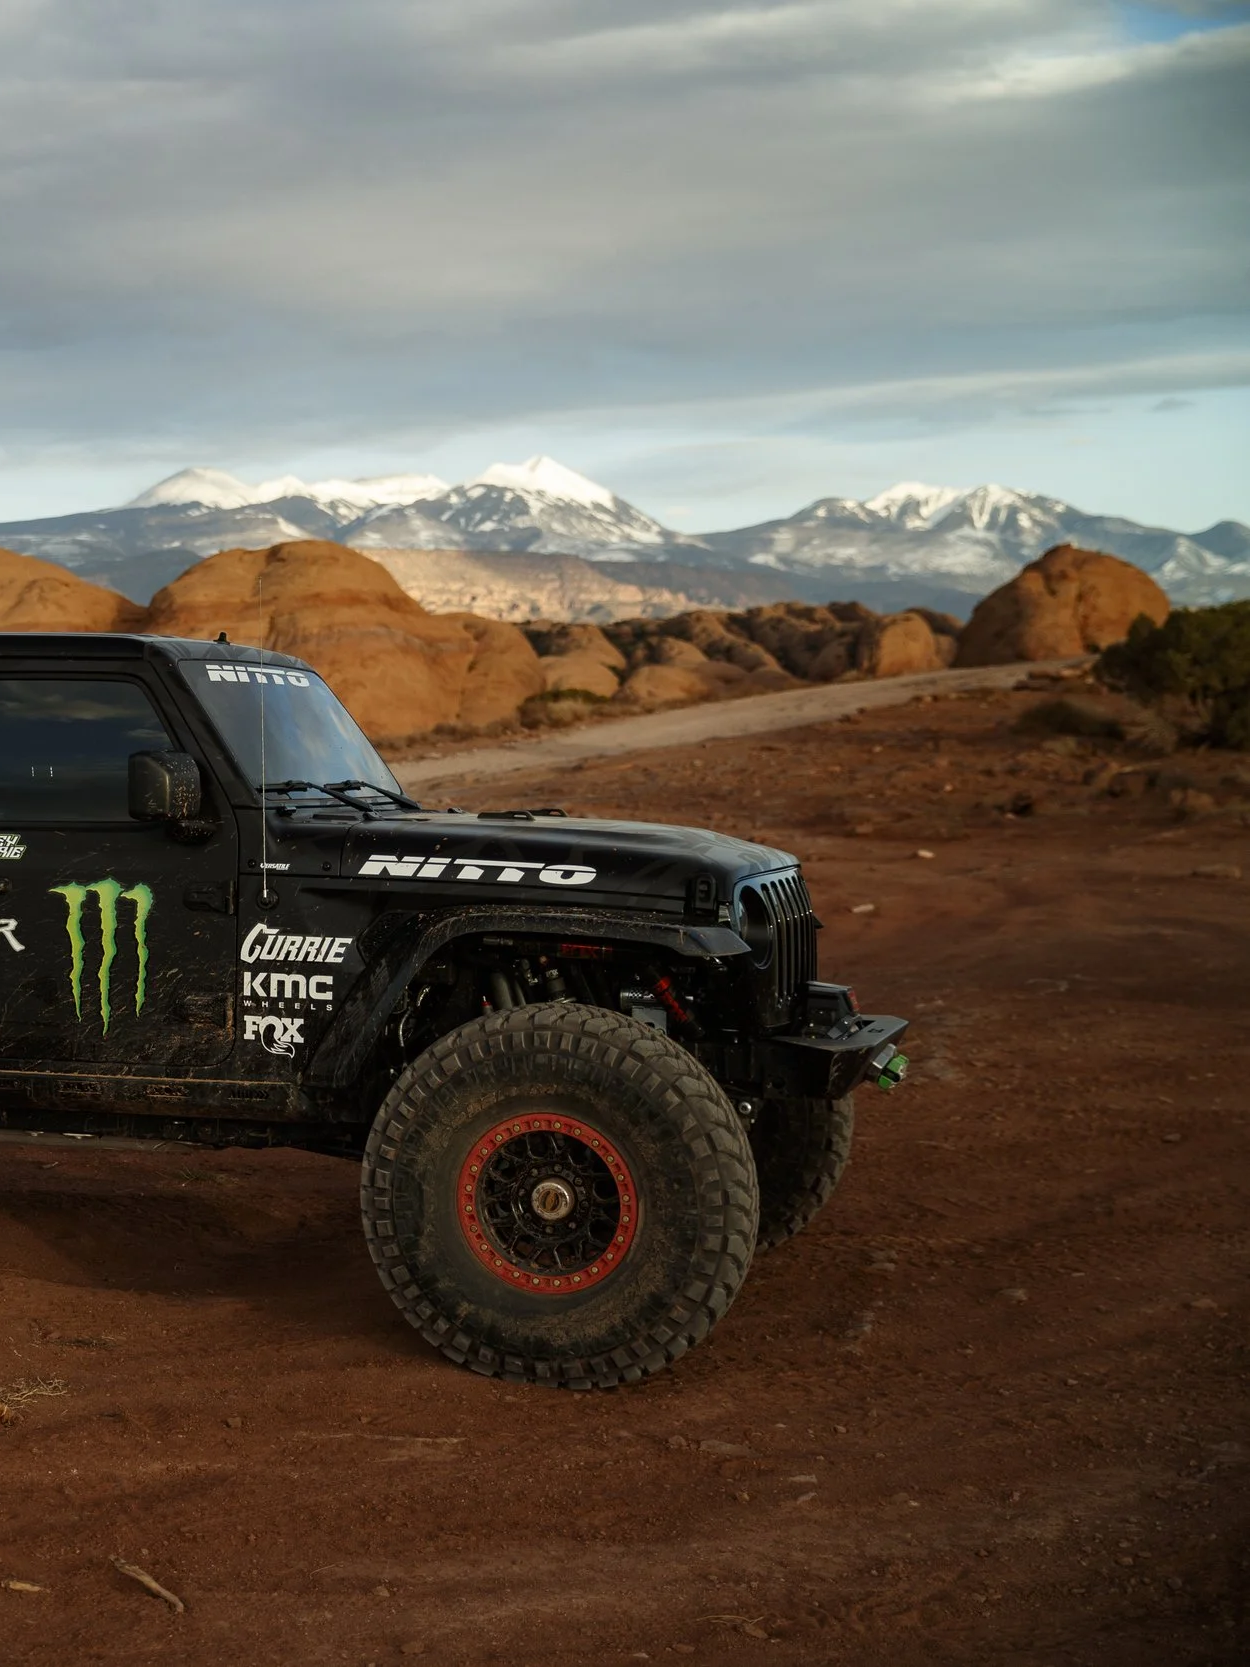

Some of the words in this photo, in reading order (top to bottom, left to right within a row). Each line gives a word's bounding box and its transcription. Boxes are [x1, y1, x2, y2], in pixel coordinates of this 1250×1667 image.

[206, 665, 310, 687] NITTO
[358, 855, 597, 885] NITTO
[243, 1000, 333, 1011] WHEELS
[243, 1014, 305, 1058] FOX
